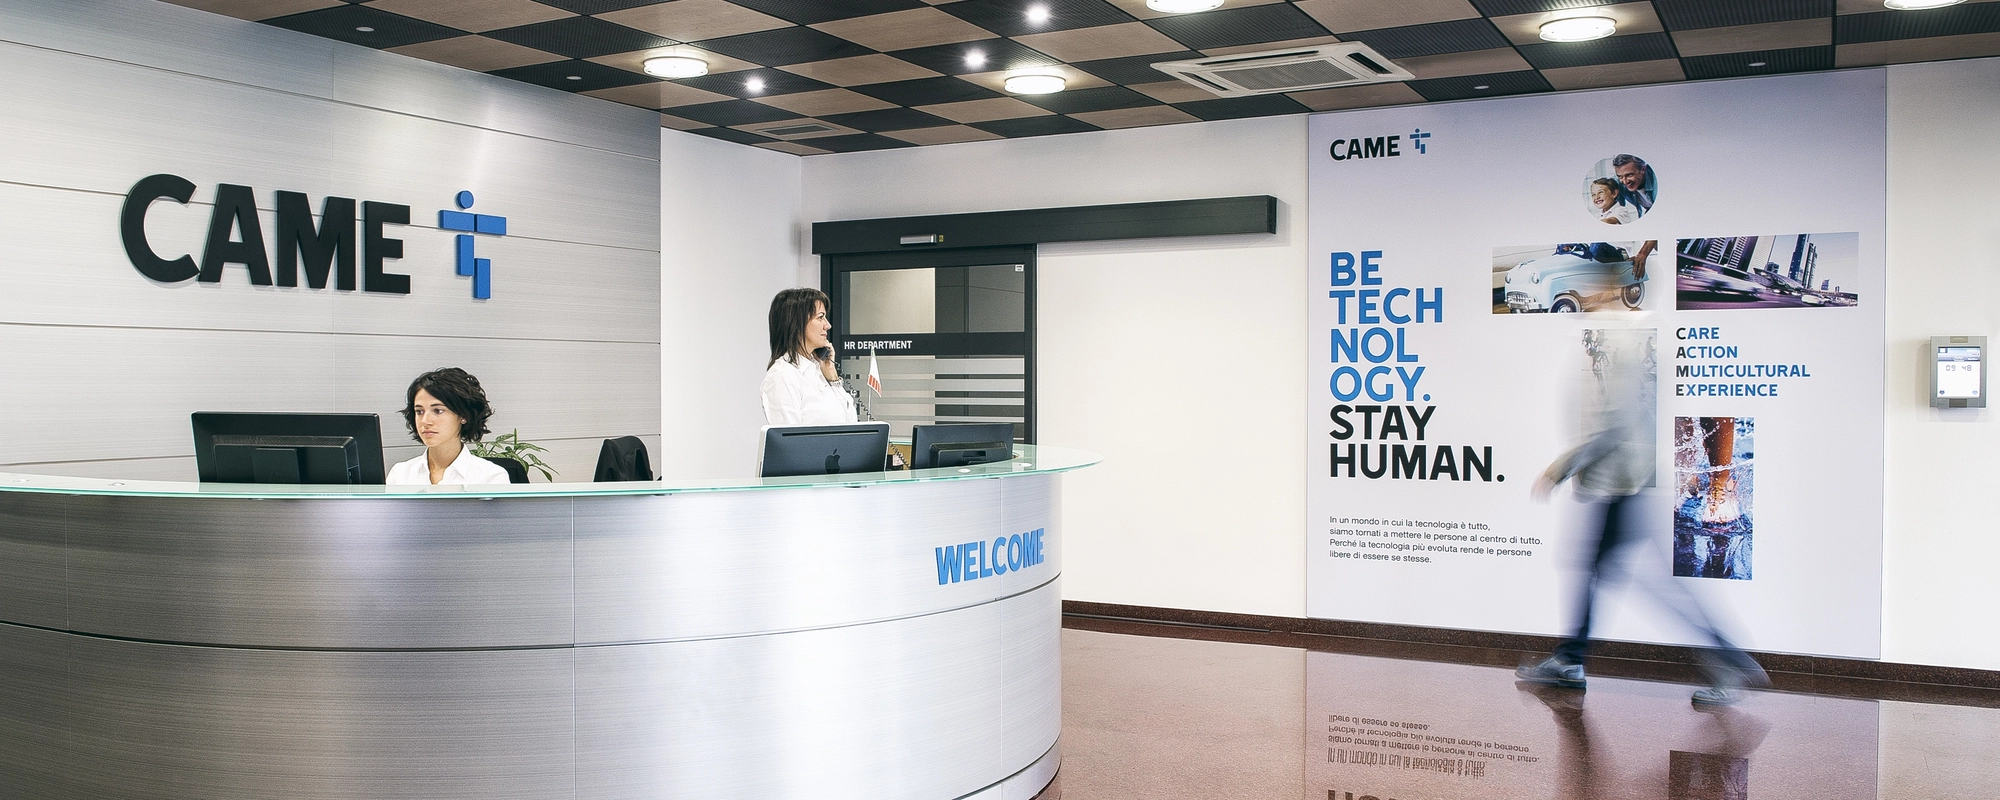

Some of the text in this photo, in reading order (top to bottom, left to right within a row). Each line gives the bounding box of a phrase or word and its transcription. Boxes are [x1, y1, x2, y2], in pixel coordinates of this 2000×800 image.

[1329, 135, 1401, 162] CAME
[120, 173, 411, 295] CAME
[1330, 250, 1383, 287] BE
[1329, 287, 1443, 325] TECH
[1675, 326, 1720, 341] CARE
[844, 340, 913, 350] HR DEPARTMENT
[1330, 326, 1419, 364] NOL
[1675, 345, 1738, 360] ACTION
[1675, 364, 1811, 379] MULTICULTURAL
[1329, 365, 1431, 403] OGY.
[1675, 383, 1779, 397] EXPERIENCE
[1329, 404, 1437, 441] STAY
[1329, 442, 1505, 483] HUMAN.
[1352, 517, 1380, 525] mondo
[1405, 519, 1413, 527] la
[1415, 520, 1458, 530] tecnologia
[1468, 522, 1491, 531] tutto,
[1329, 539, 1357, 547] Perché
[1359, 540, 1366, 548] la
[1368, 541, 1410, 551] tecnologia
[1412, 543, 1425, 552] più
[1427, 544, 1458, 552] evoluta
[1486, 547, 1494, 555] le
[1496, 549, 1532, 557] persone
[1356, 529, 1381, 537] tornati
[1391, 531, 1422, 539] mettere
[1434, 533, 1468, 541] persone
[1470, 534, 1478, 542] al
[1480, 535, 1507, 544] centro
[1509, 536, 1518, 544] di
[1520, 537, 1543, 545] tutto.
[935, 527, 1044, 585] WELCOME
[1329, 550, 1351, 558] libere
[1353, 551, 1361, 559] di
[1363, 553, 1389, 561] essere
[1403, 555, 1432, 563] stesse.
